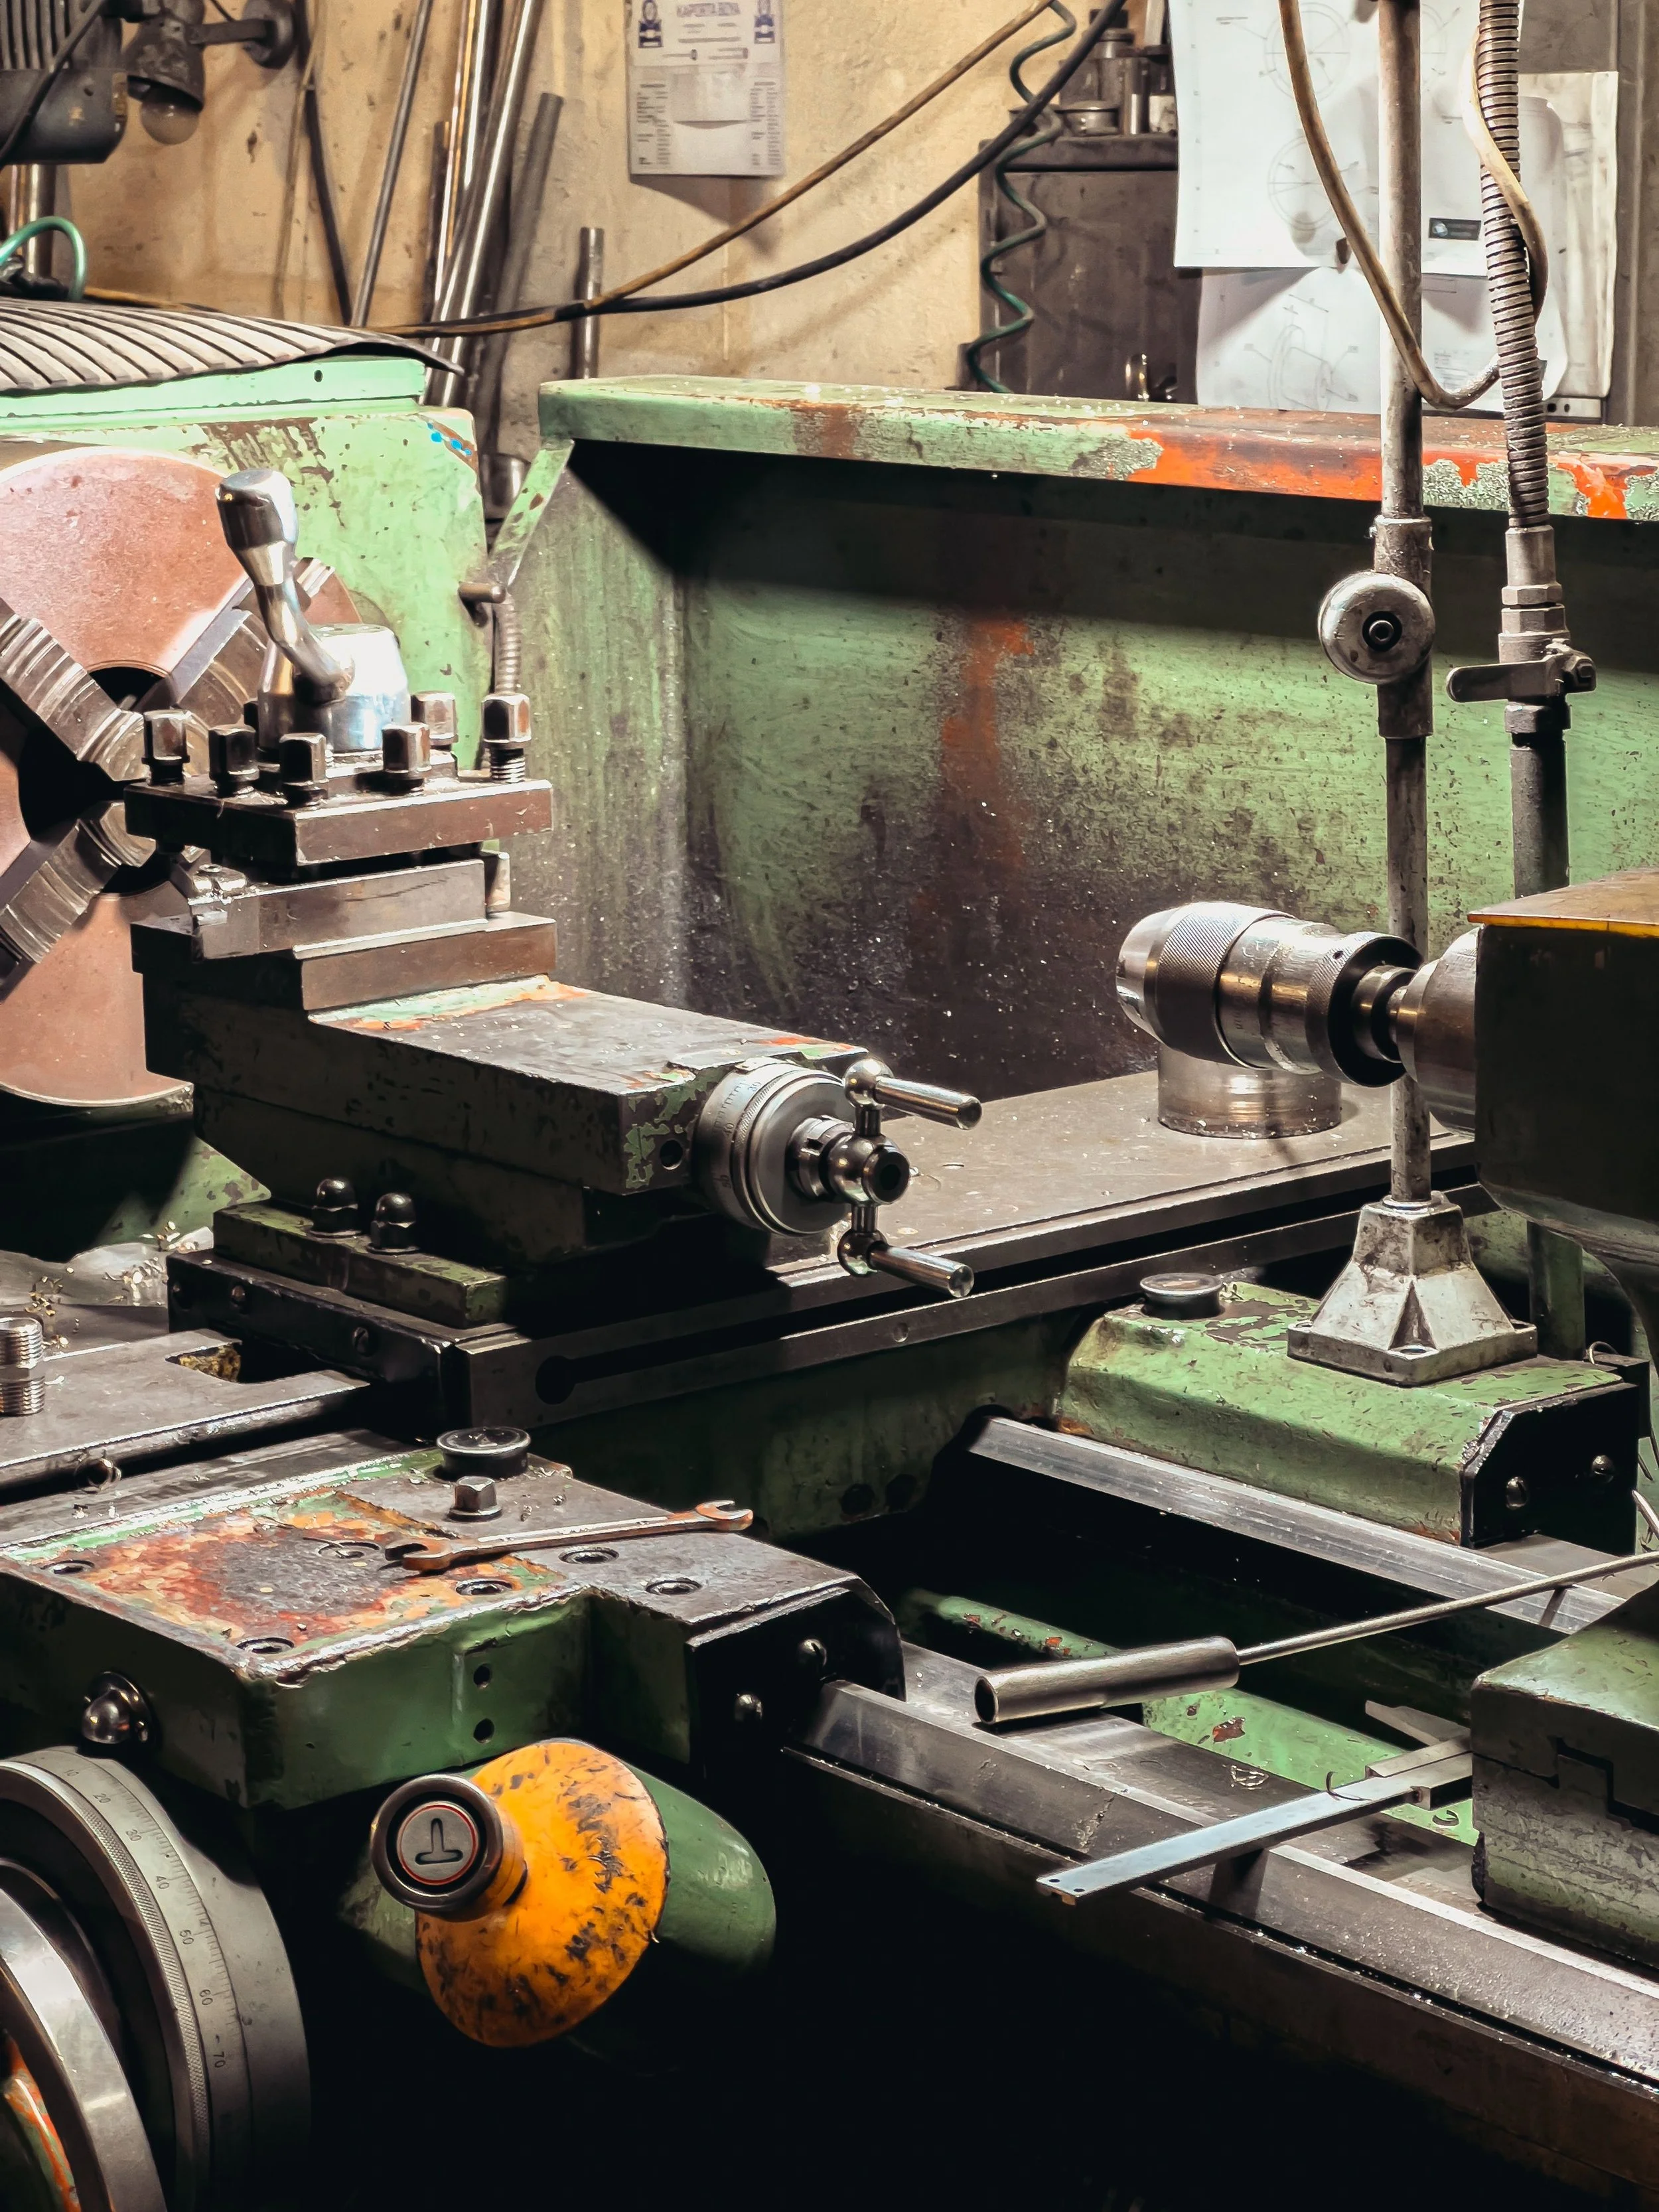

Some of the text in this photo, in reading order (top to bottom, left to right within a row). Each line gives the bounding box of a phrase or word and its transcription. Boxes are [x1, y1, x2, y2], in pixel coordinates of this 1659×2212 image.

[93, 1793, 110, 1803] 20
[126, 1829, 141, 1841] 30
[156, 1876, 170, 1889] 40
[179, 1930, 194, 1945] 50
[199, 1989, 214, 2006] 60
[213, 2051, 226, 2069] 70
